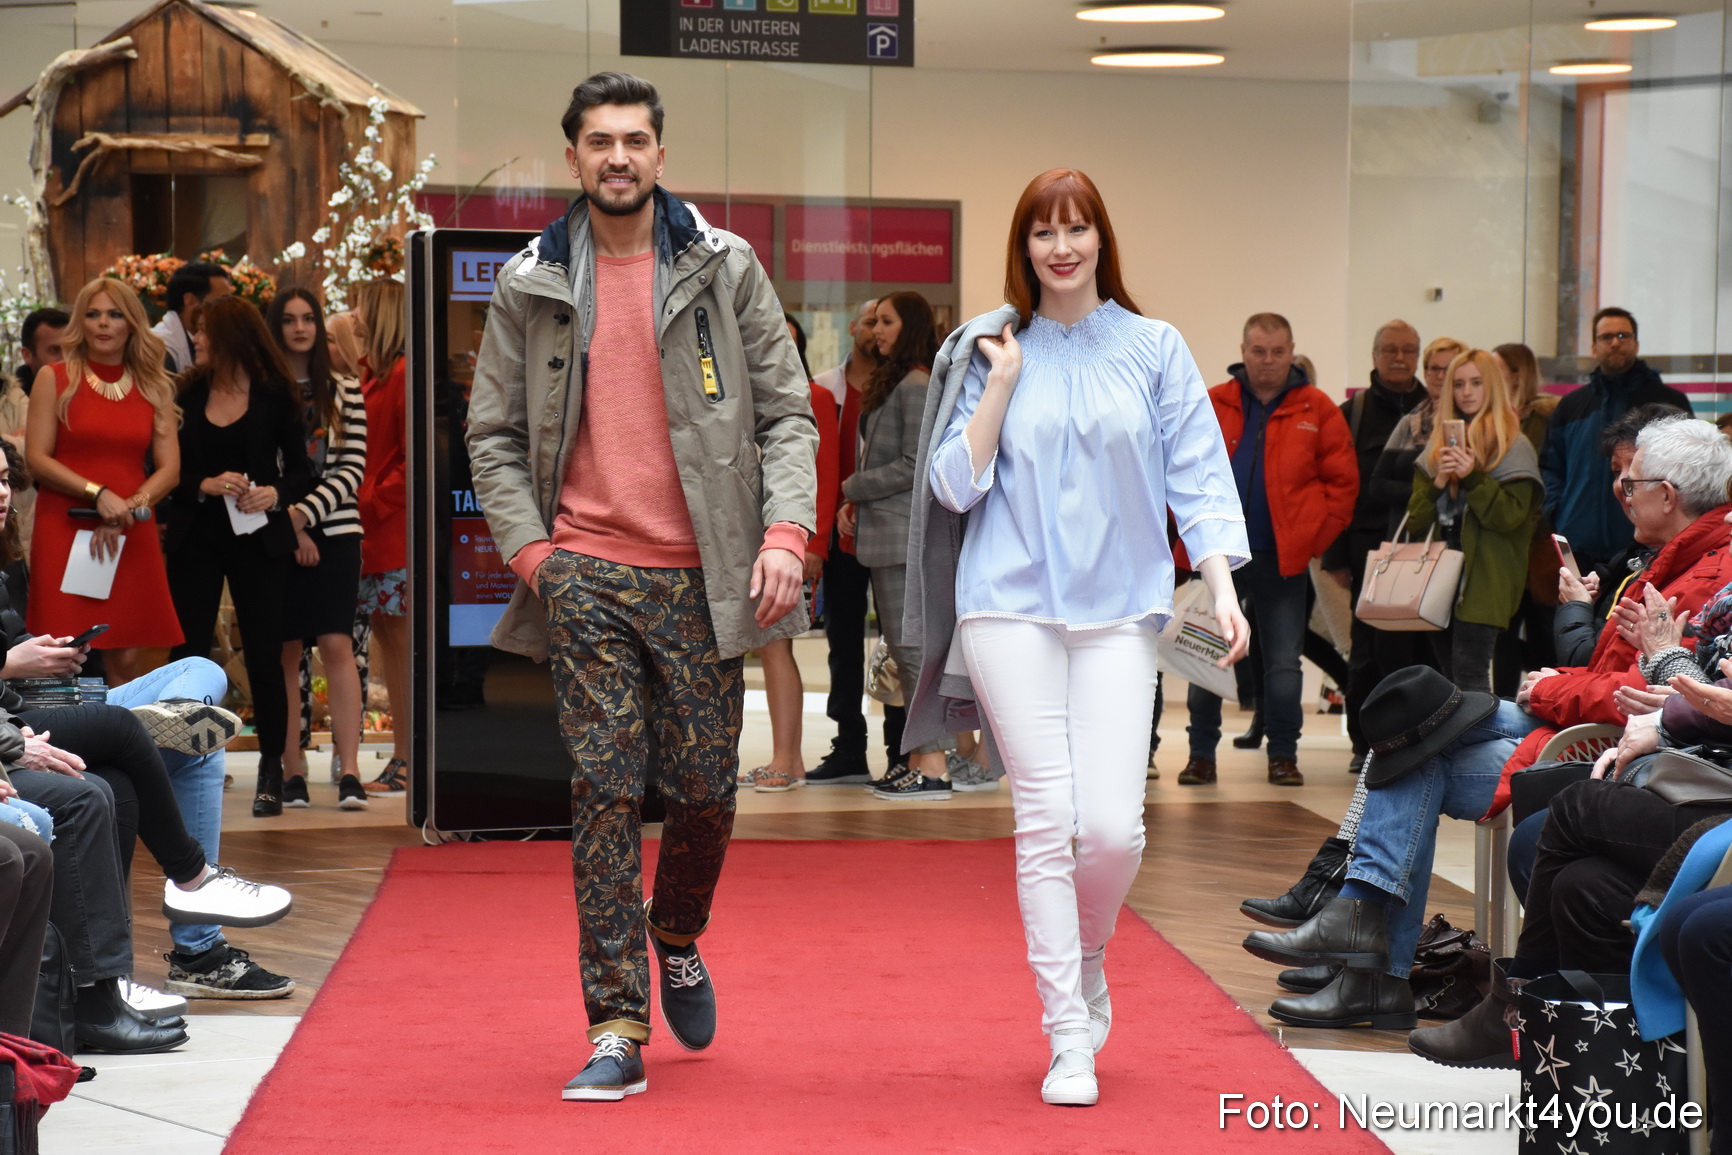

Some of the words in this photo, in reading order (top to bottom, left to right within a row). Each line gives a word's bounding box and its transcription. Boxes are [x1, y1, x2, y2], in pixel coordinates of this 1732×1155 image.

[679, 17, 694, 32] IN
[698, 18, 724, 33] DER
[730, 20, 800, 36] UNTEREN
[679, 37, 800, 57] LADENSTRASSE
[791, 239, 944, 258] Dienstleistungsflächen
